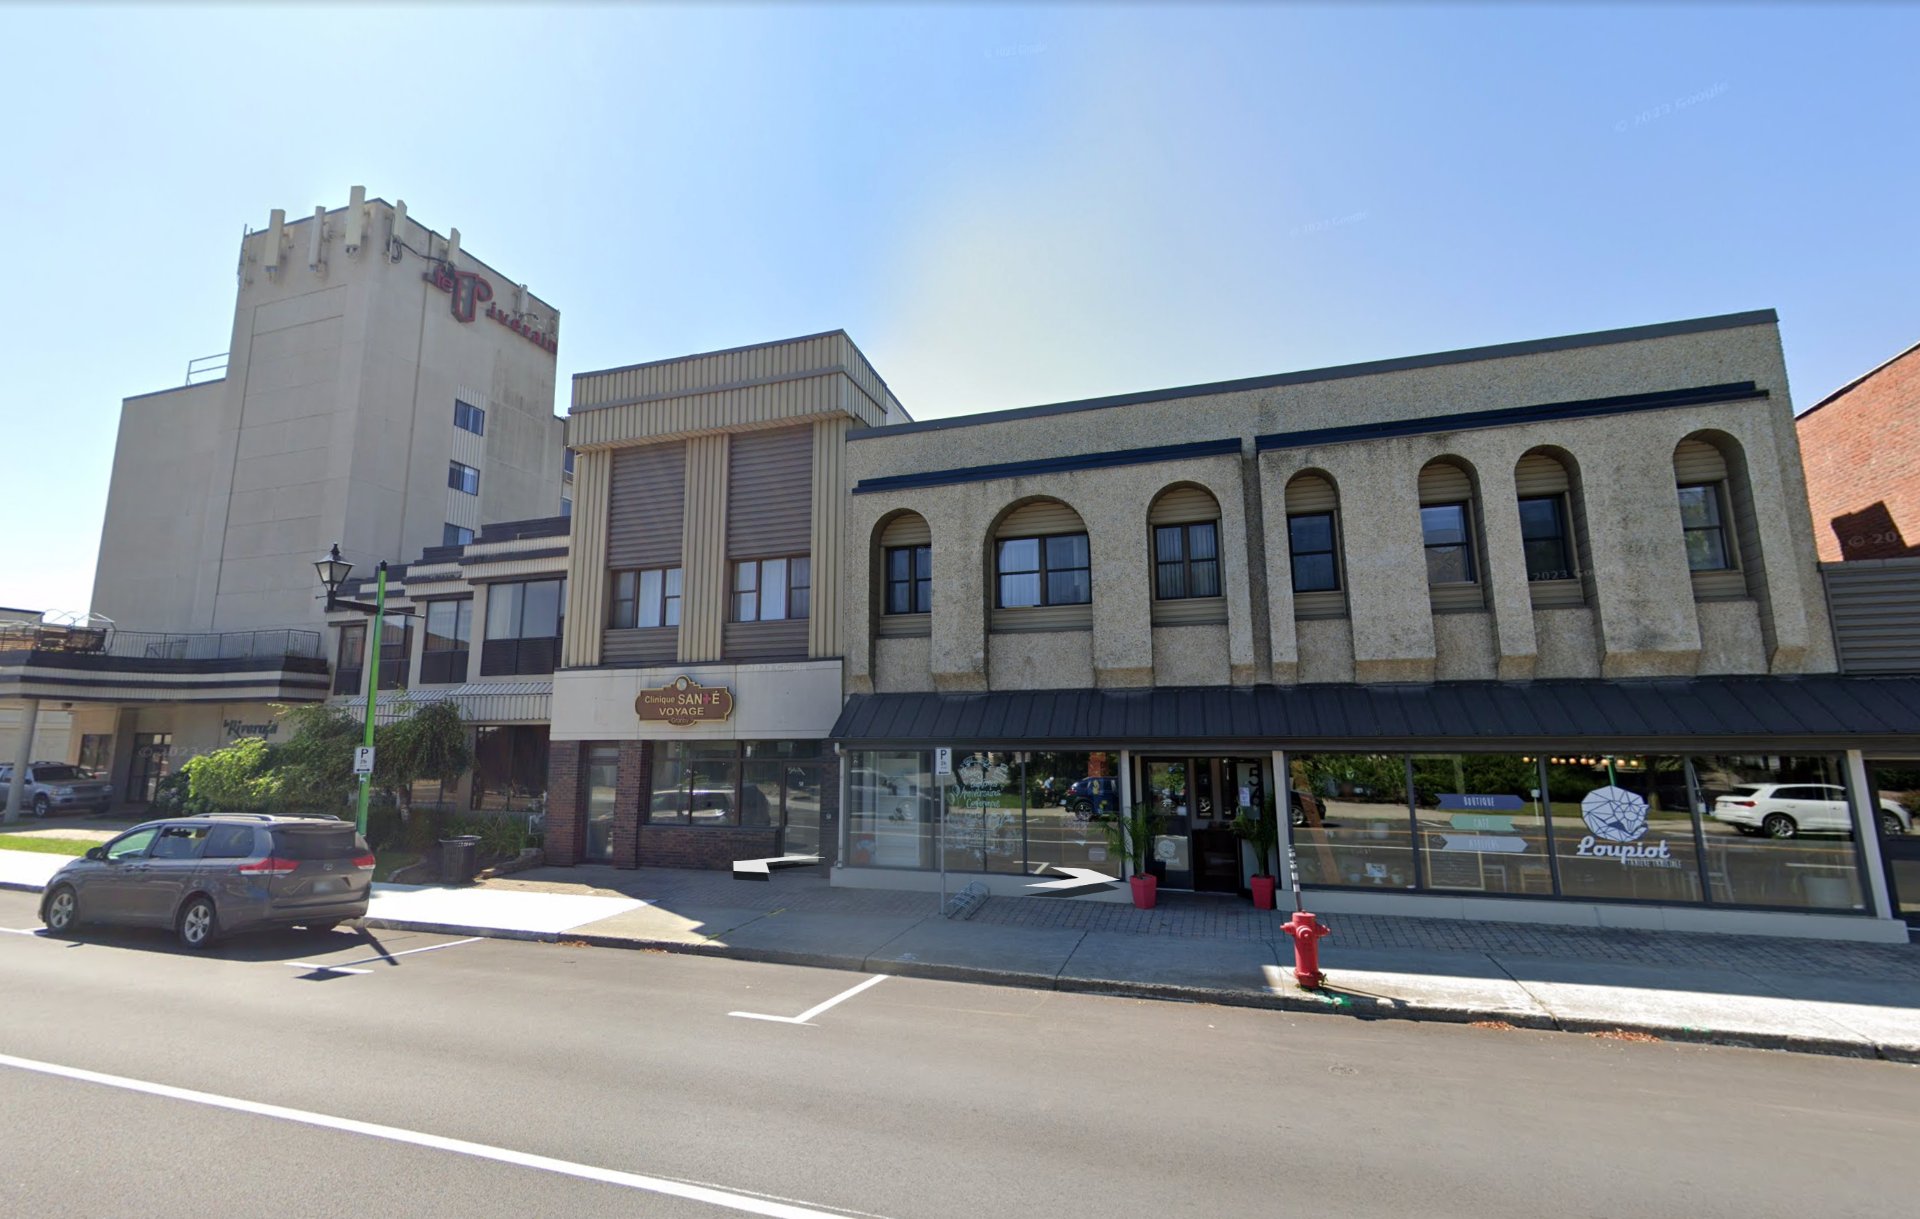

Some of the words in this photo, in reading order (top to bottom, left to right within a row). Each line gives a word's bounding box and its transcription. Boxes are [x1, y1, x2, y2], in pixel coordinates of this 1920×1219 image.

[644, 695, 676, 705] Clinique
[659, 707, 705, 716] VOYAGE
[361, 748, 369, 758] P
[940, 749, 948, 760] P
[1463, 796, 1495, 807] BOUTIQUE
[1576, 835, 1671, 864] Loupiot
